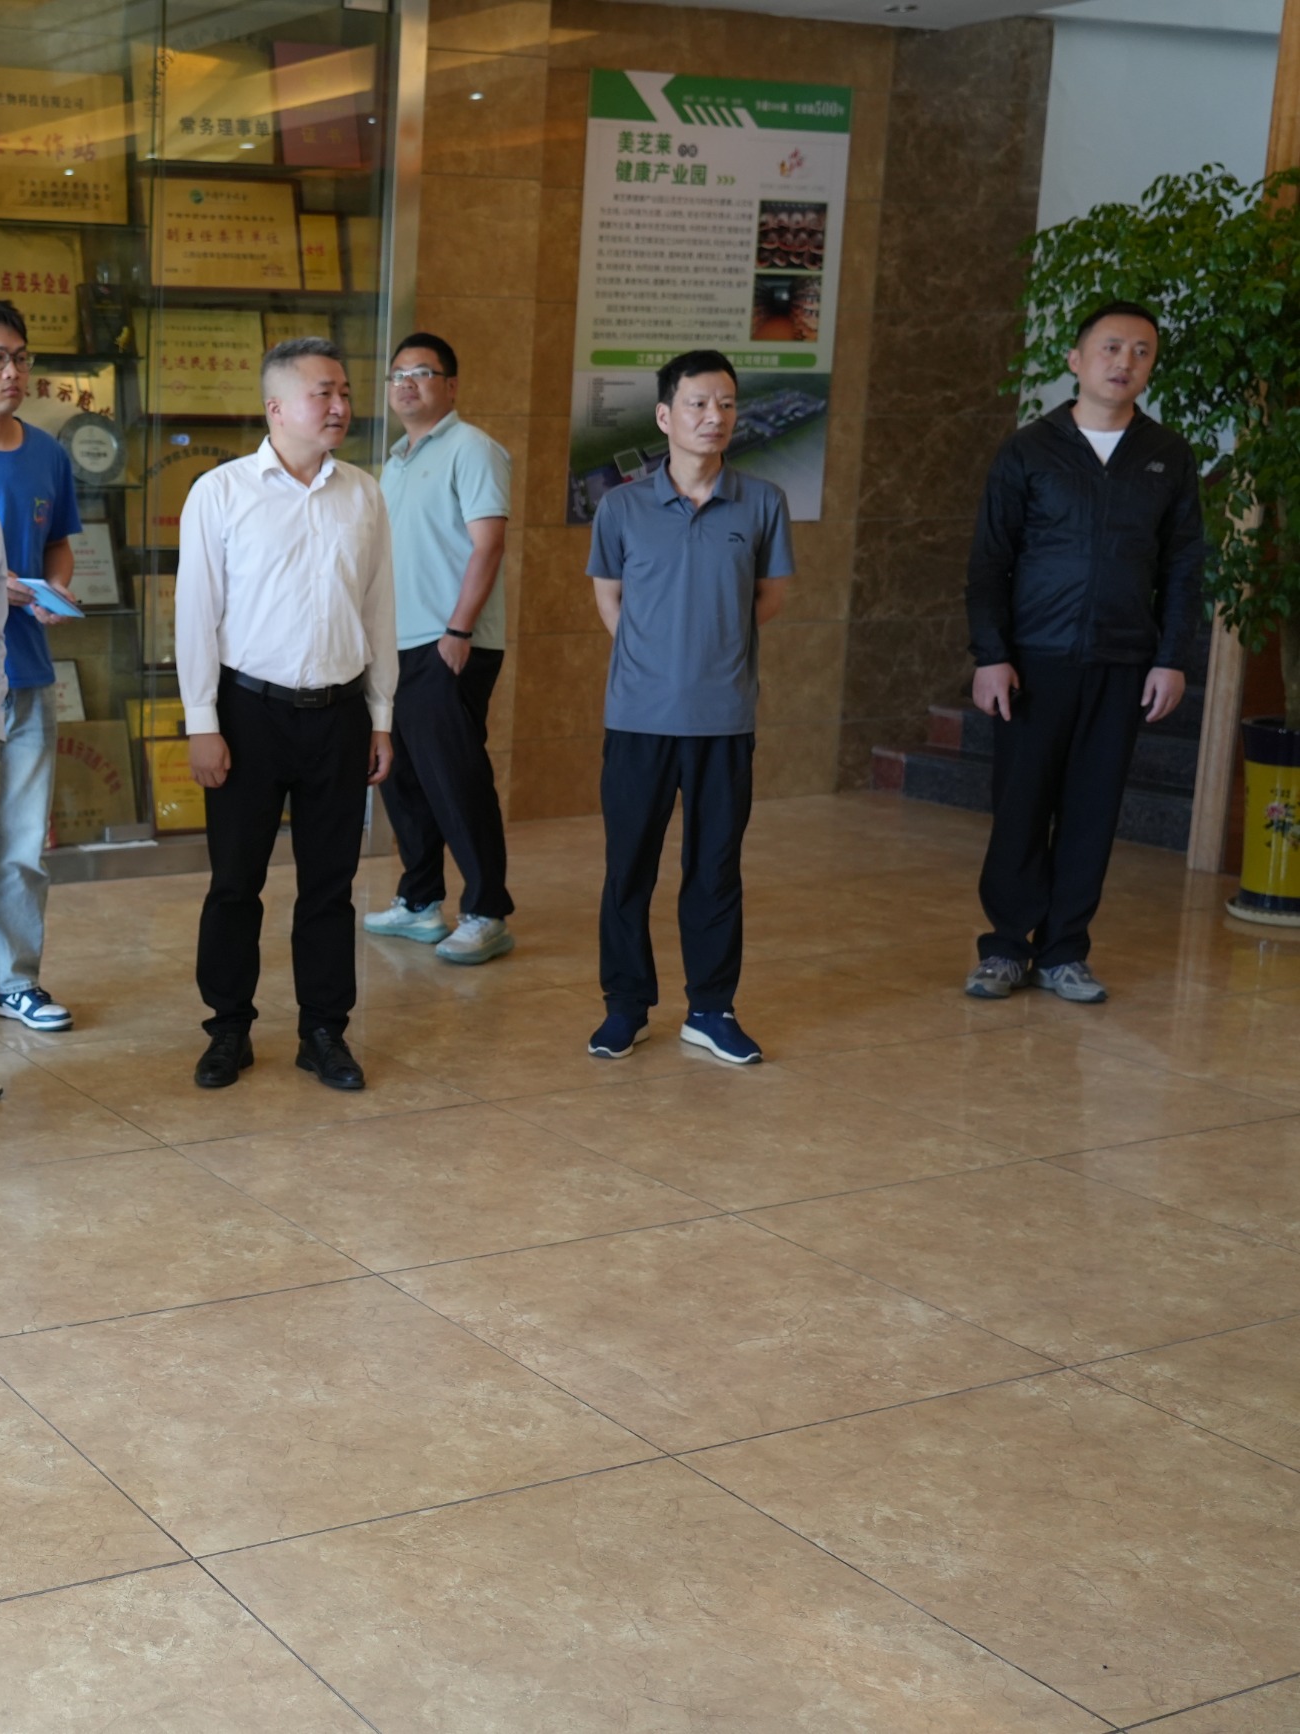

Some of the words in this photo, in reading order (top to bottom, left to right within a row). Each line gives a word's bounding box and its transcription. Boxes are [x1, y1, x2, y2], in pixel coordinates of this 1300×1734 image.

[617, 130, 672, 155] 美芝莱
[615, 159, 707, 186] 健康产业园
[166, 228, 279, 246] 副主任委员单位
